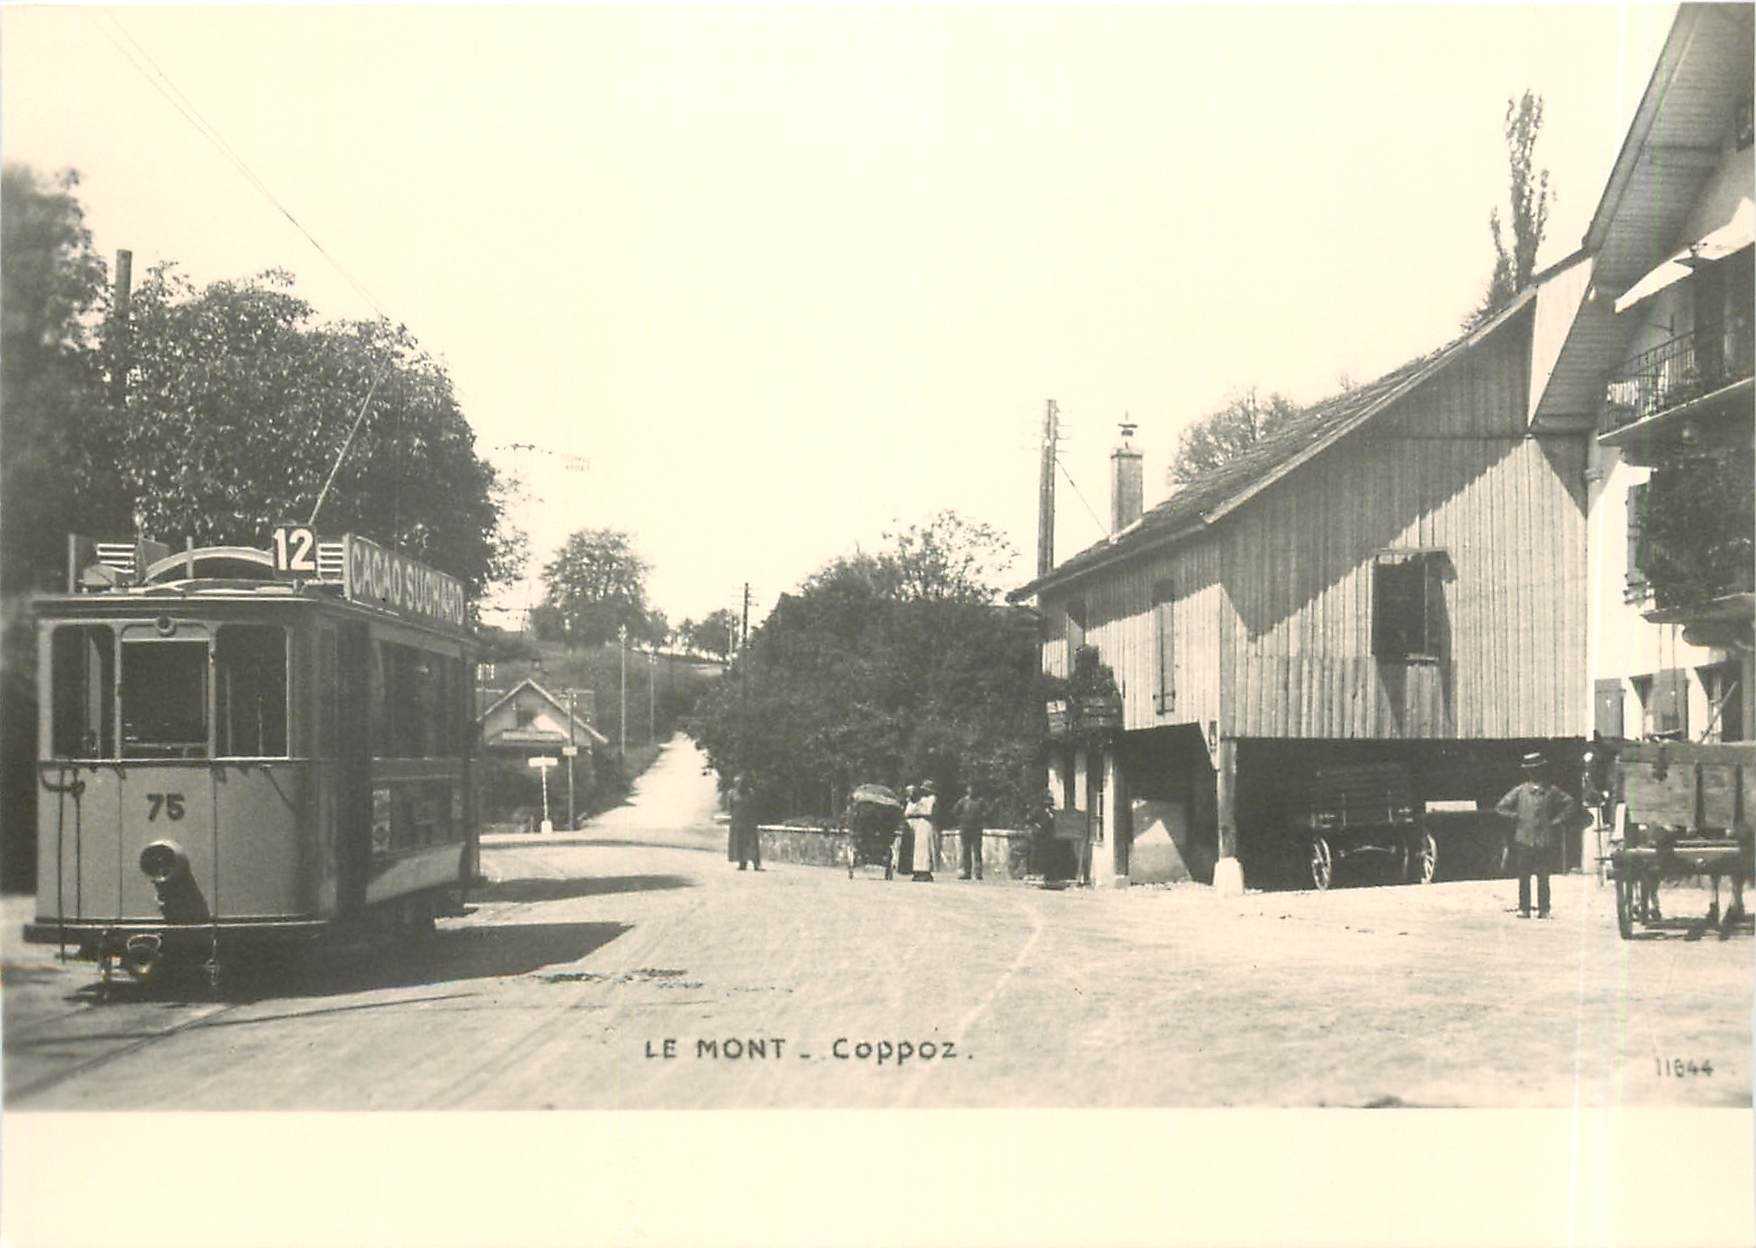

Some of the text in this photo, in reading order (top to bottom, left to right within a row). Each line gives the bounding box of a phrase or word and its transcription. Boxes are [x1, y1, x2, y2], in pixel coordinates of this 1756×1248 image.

[272, 527, 316, 571] 12
[351, 541, 401, 605] CACAO
[146, 793, 185, 822] 75
